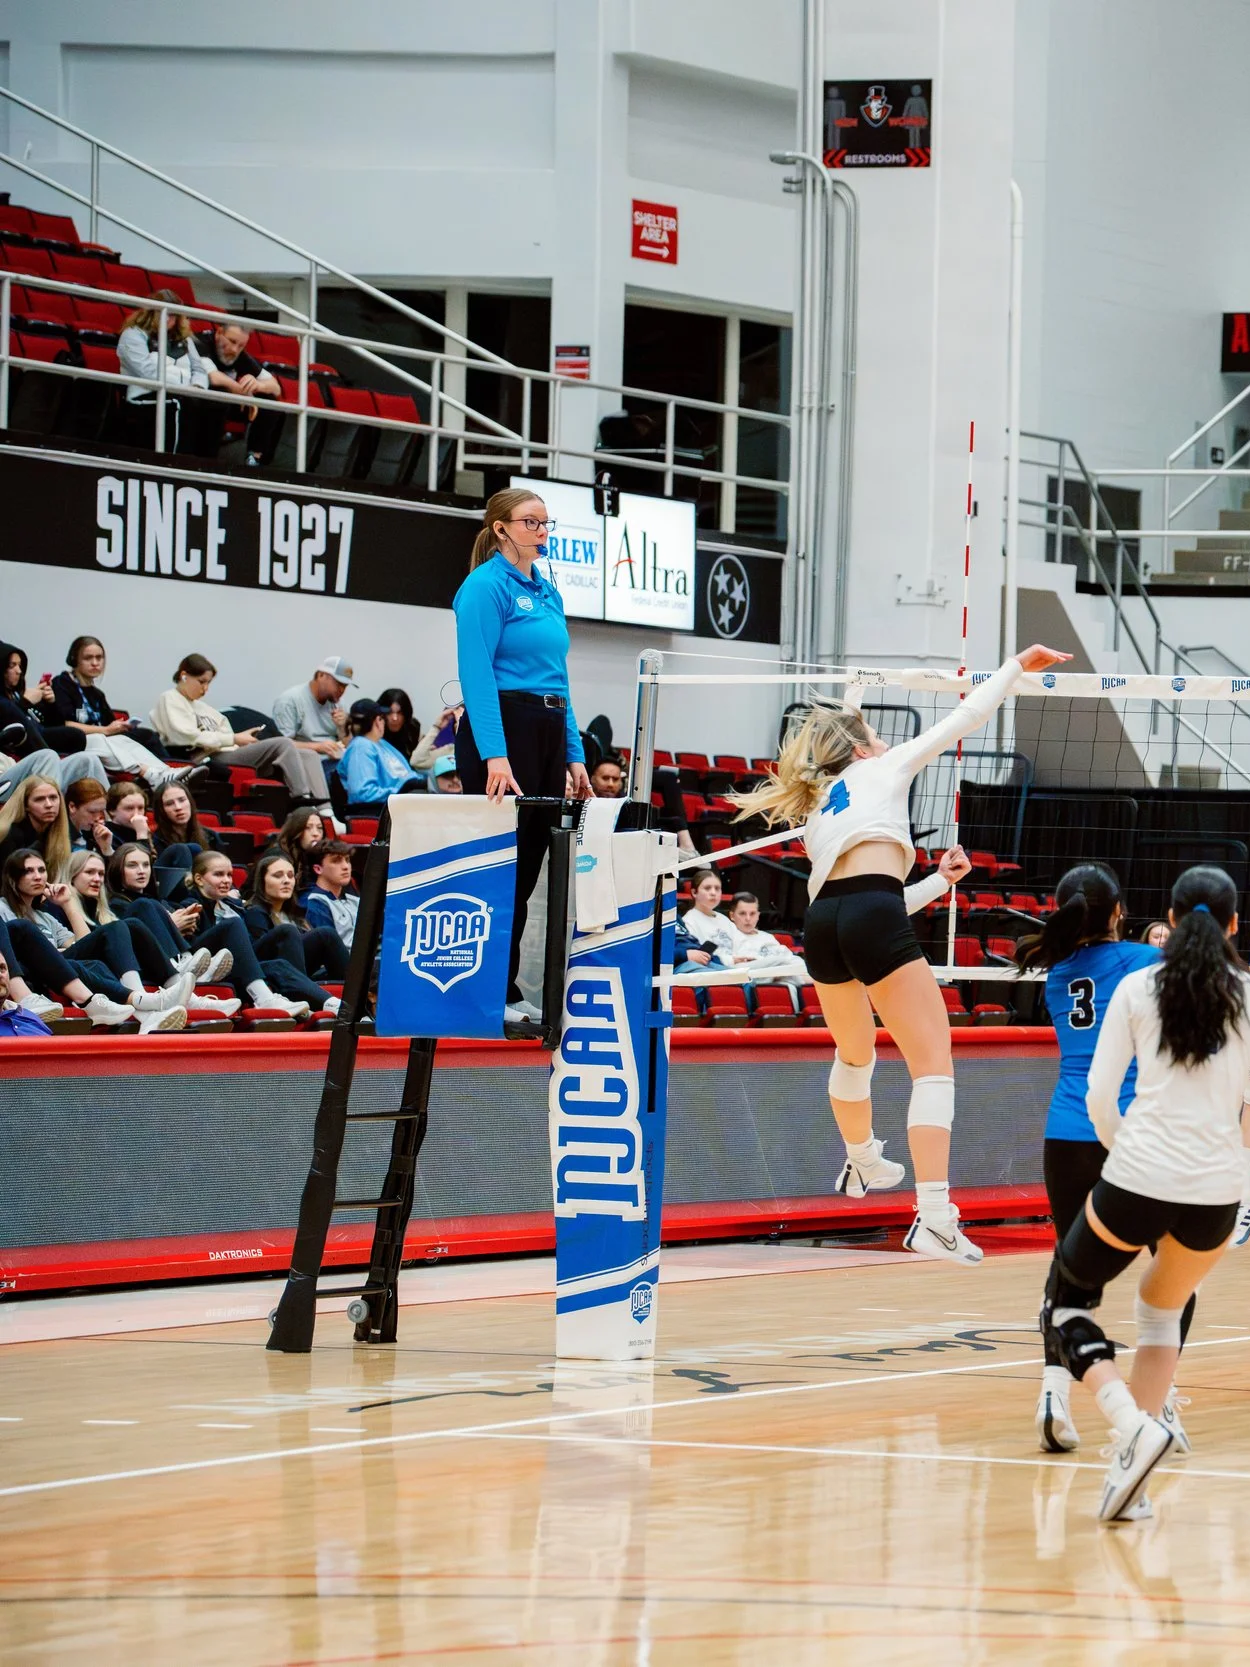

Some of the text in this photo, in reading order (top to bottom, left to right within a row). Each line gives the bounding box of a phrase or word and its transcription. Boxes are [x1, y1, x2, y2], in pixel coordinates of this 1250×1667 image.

[844, 154, 907, 165] RESTROOMS
[634, 211, 677, 231] SHELTER
[640, 225, 670, 244] AREA
[96, 475, 354, 594] SINCE 1927
[547, 536, 598, 565] RLEW
[611, 520, 690, 596] Altra
[1223, 556, 1243, 570] FF
[972, 673, 992, 686] NJCA
[1101, 677, 1127, 690] NJCAA
[406, 913, 486, 956] NJCAA
[1068, 976, 1096, 1030] 3
[556, 979, 639, 1207] NJCAA
[209, 1248, 263, 1260] DAKTRONICS
[631, 1290, 652, 1312] NJCAA
